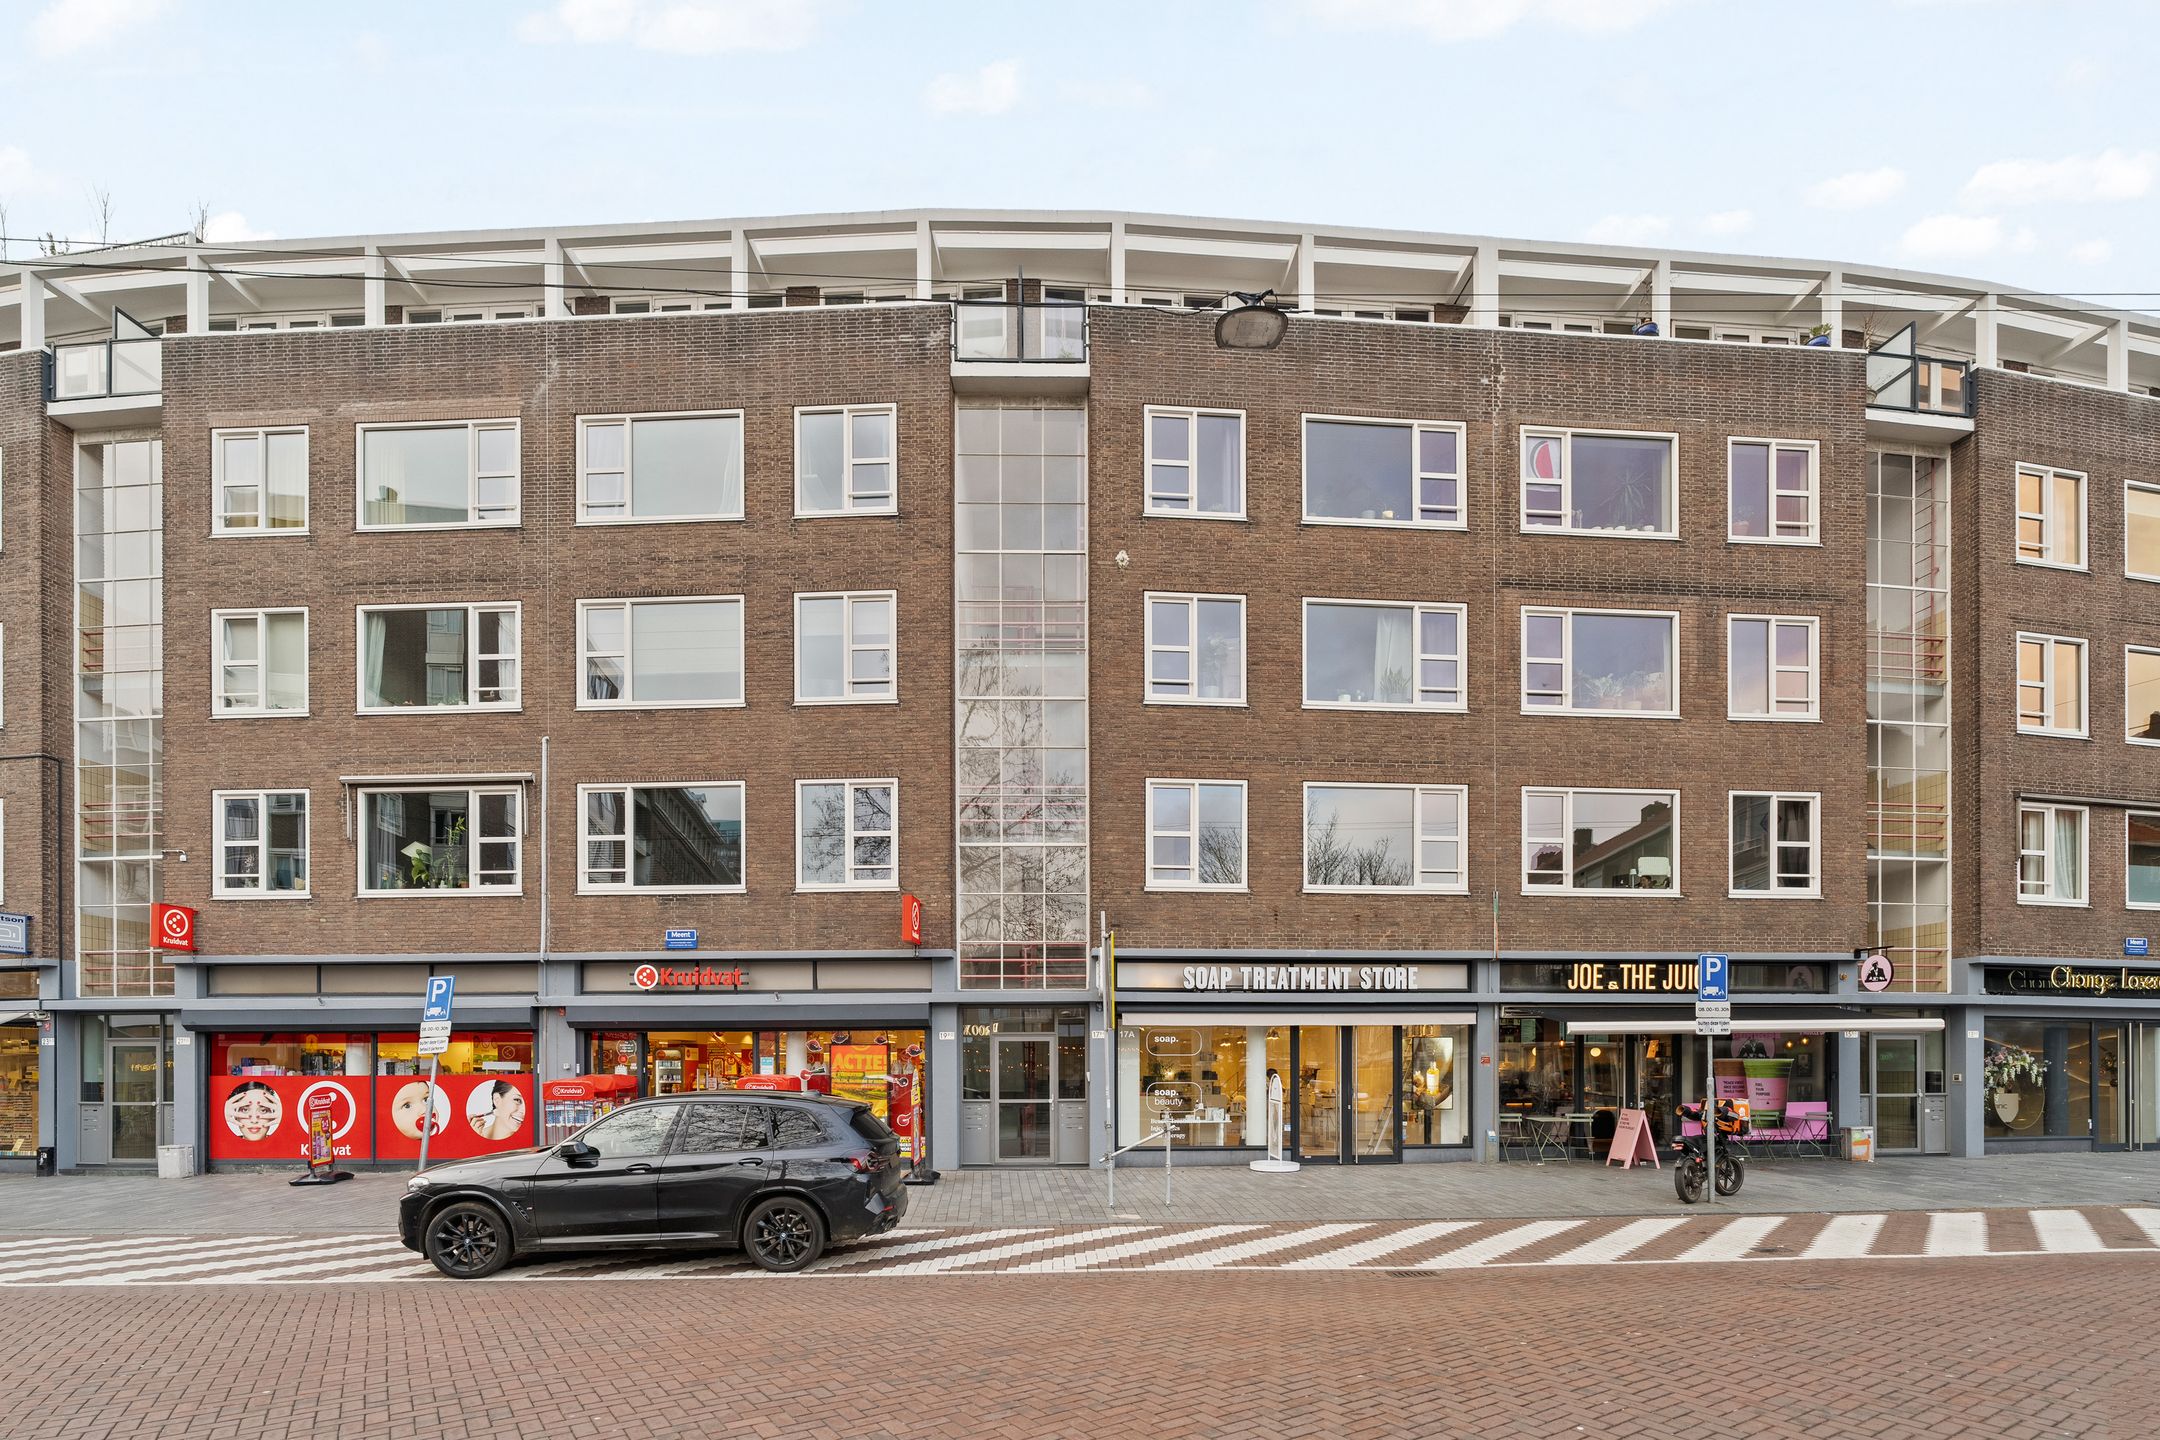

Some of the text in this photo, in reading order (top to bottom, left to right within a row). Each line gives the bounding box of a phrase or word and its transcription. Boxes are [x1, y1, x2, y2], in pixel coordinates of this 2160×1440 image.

[162, 936, 189, 946] Kruidvat
[660, 966, 743, 987] Kruidvat
[1183, 966, 1419, 990] SOAP TREATMENT STORE
[1567, 963, 1604, 990] JOE
[1607, 980, 1620, 990] &
[1619, 963, 1657, 990] THE
[1706, 957, 1722, 982] P
[431, 980, 447, 1003] P
[1154, 1036, 1179, 1044] soap.
[1154, 1089, 1179, 1097] soap.
[1154, 1097, 1183, 1107] beauty
[300, 1143, 352, 1156] Kvat
